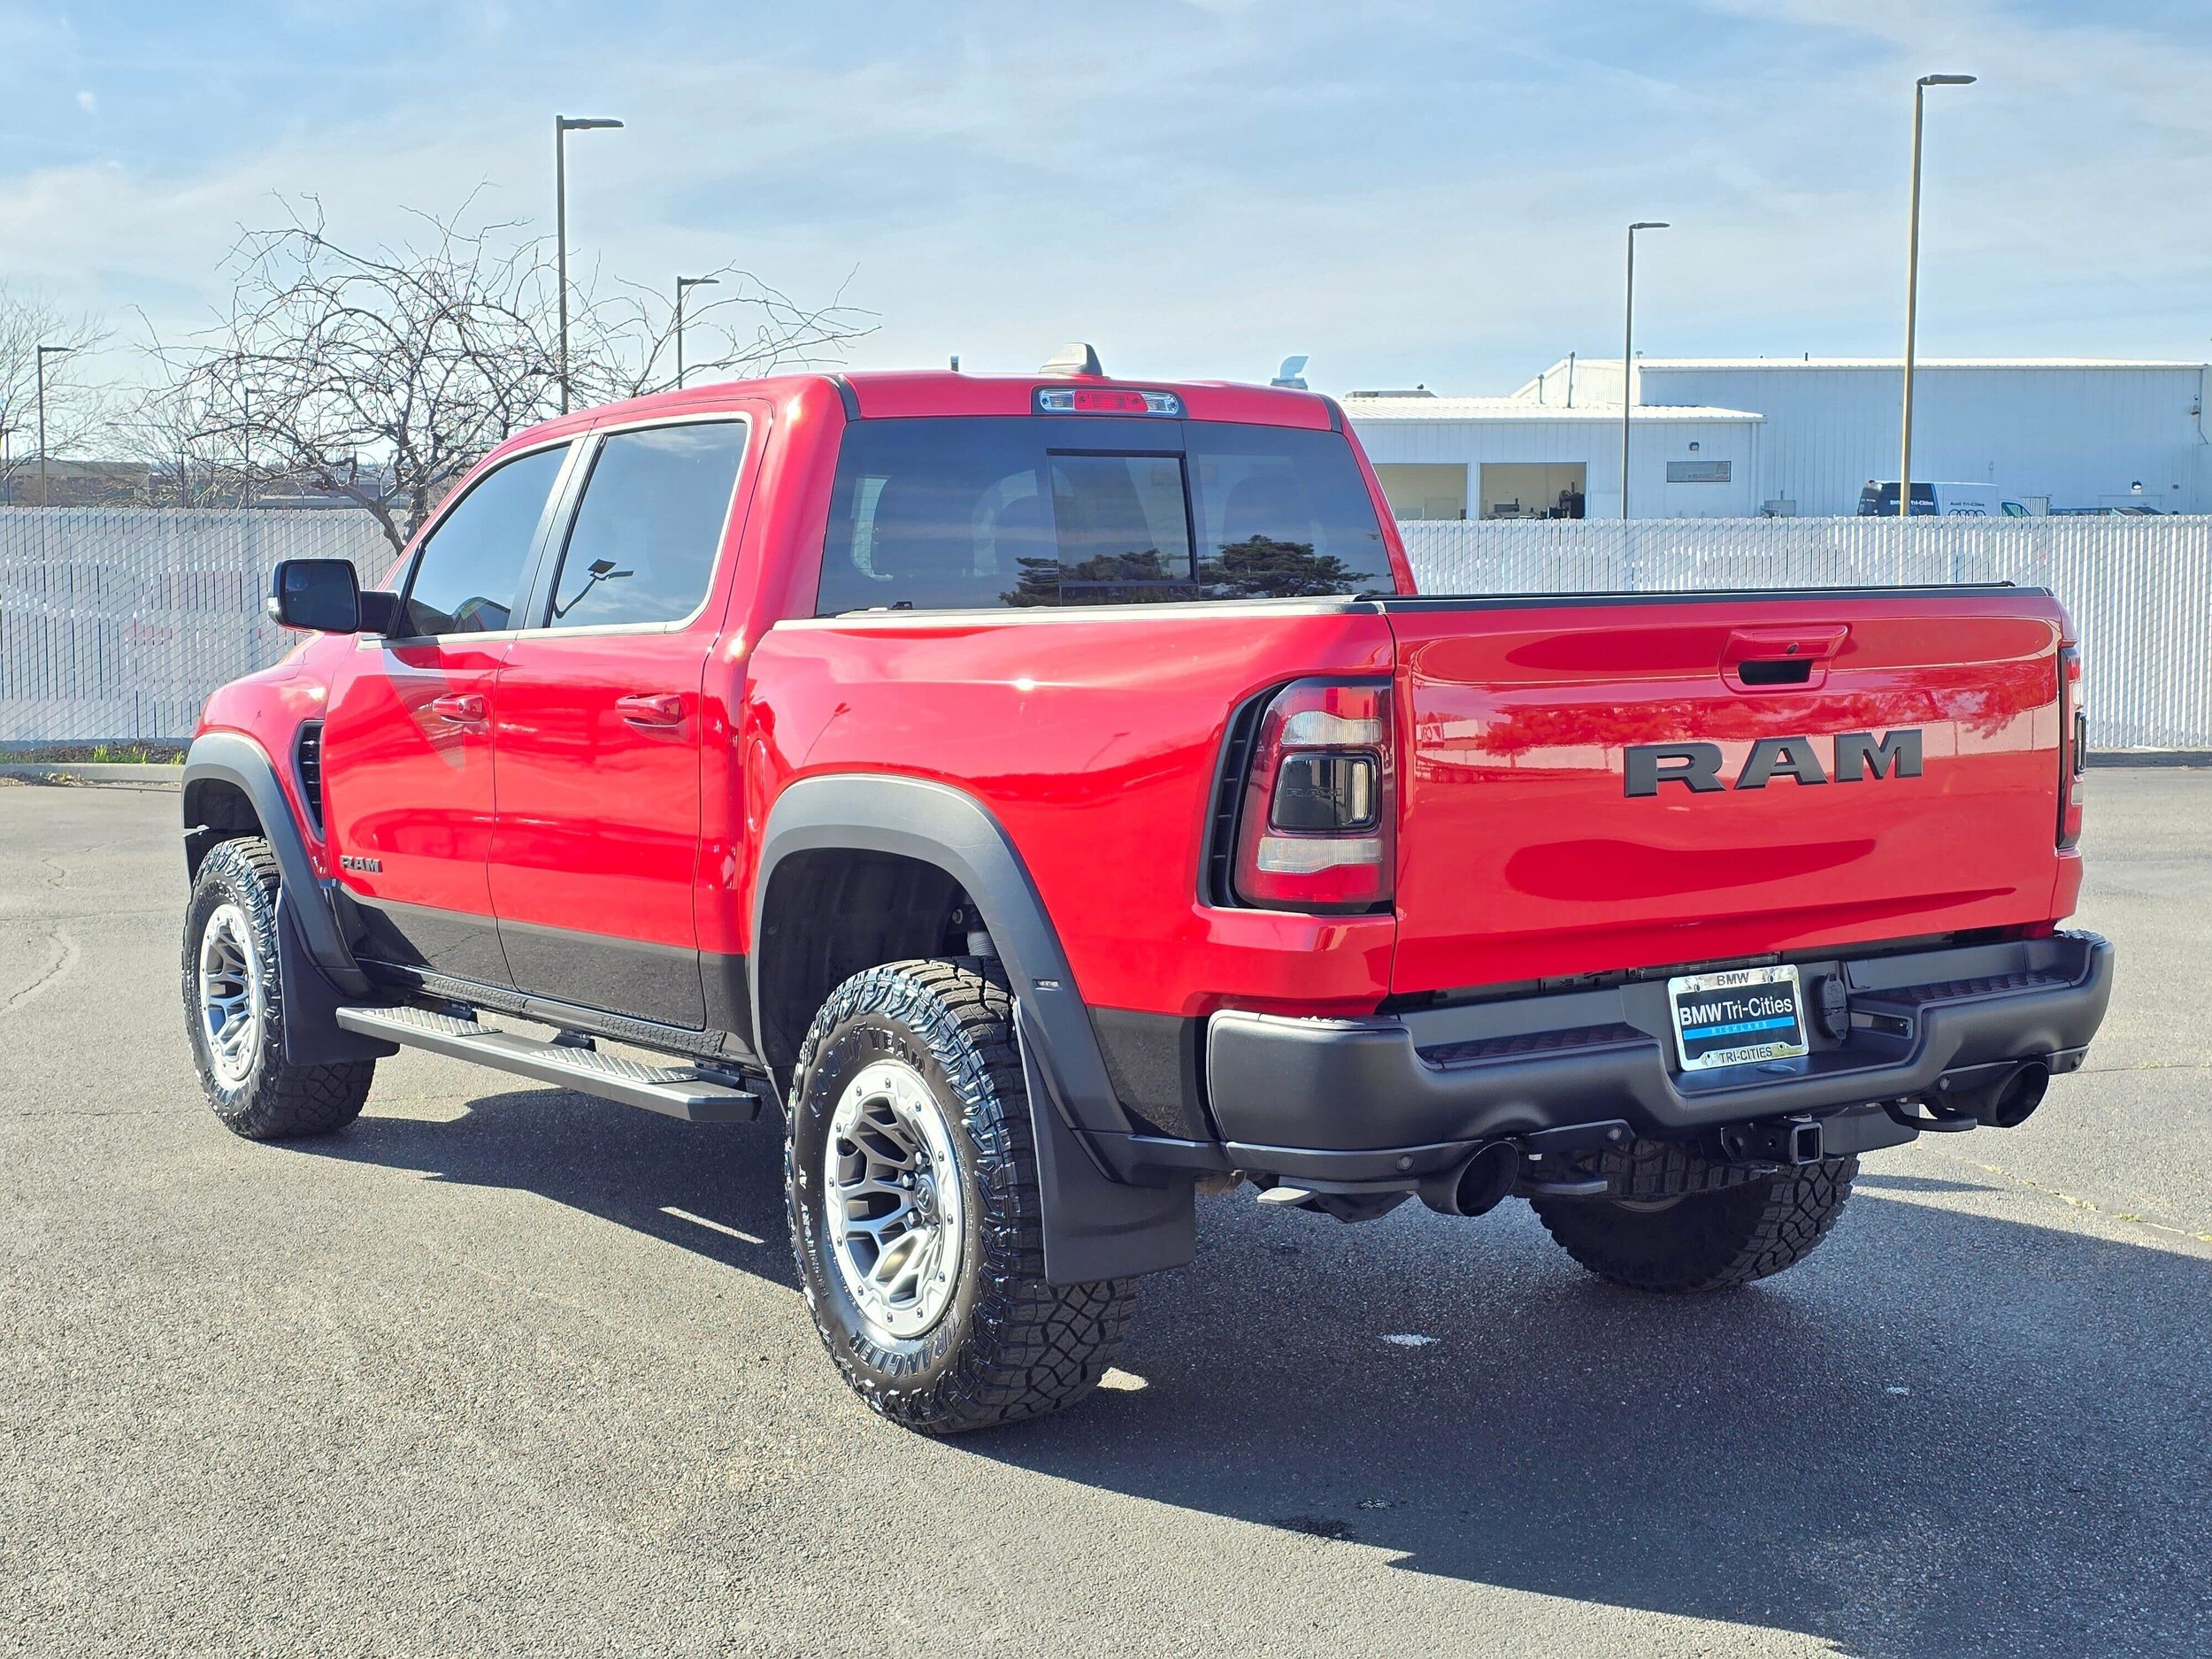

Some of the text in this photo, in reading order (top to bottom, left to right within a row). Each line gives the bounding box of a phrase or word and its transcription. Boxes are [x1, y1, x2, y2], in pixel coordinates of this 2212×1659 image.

[1624, 729, 1923, 798] RAM
[340, 855, 383, 873] RAM
[1717, 972, 1749, 986] BMW
[1679, 996, 1793, 1025] BMW Tri-Cities
[1719, 1047, 1773, 1064] TRI-CITIES
[849, 1302, 962, 1378] WRANGLER
